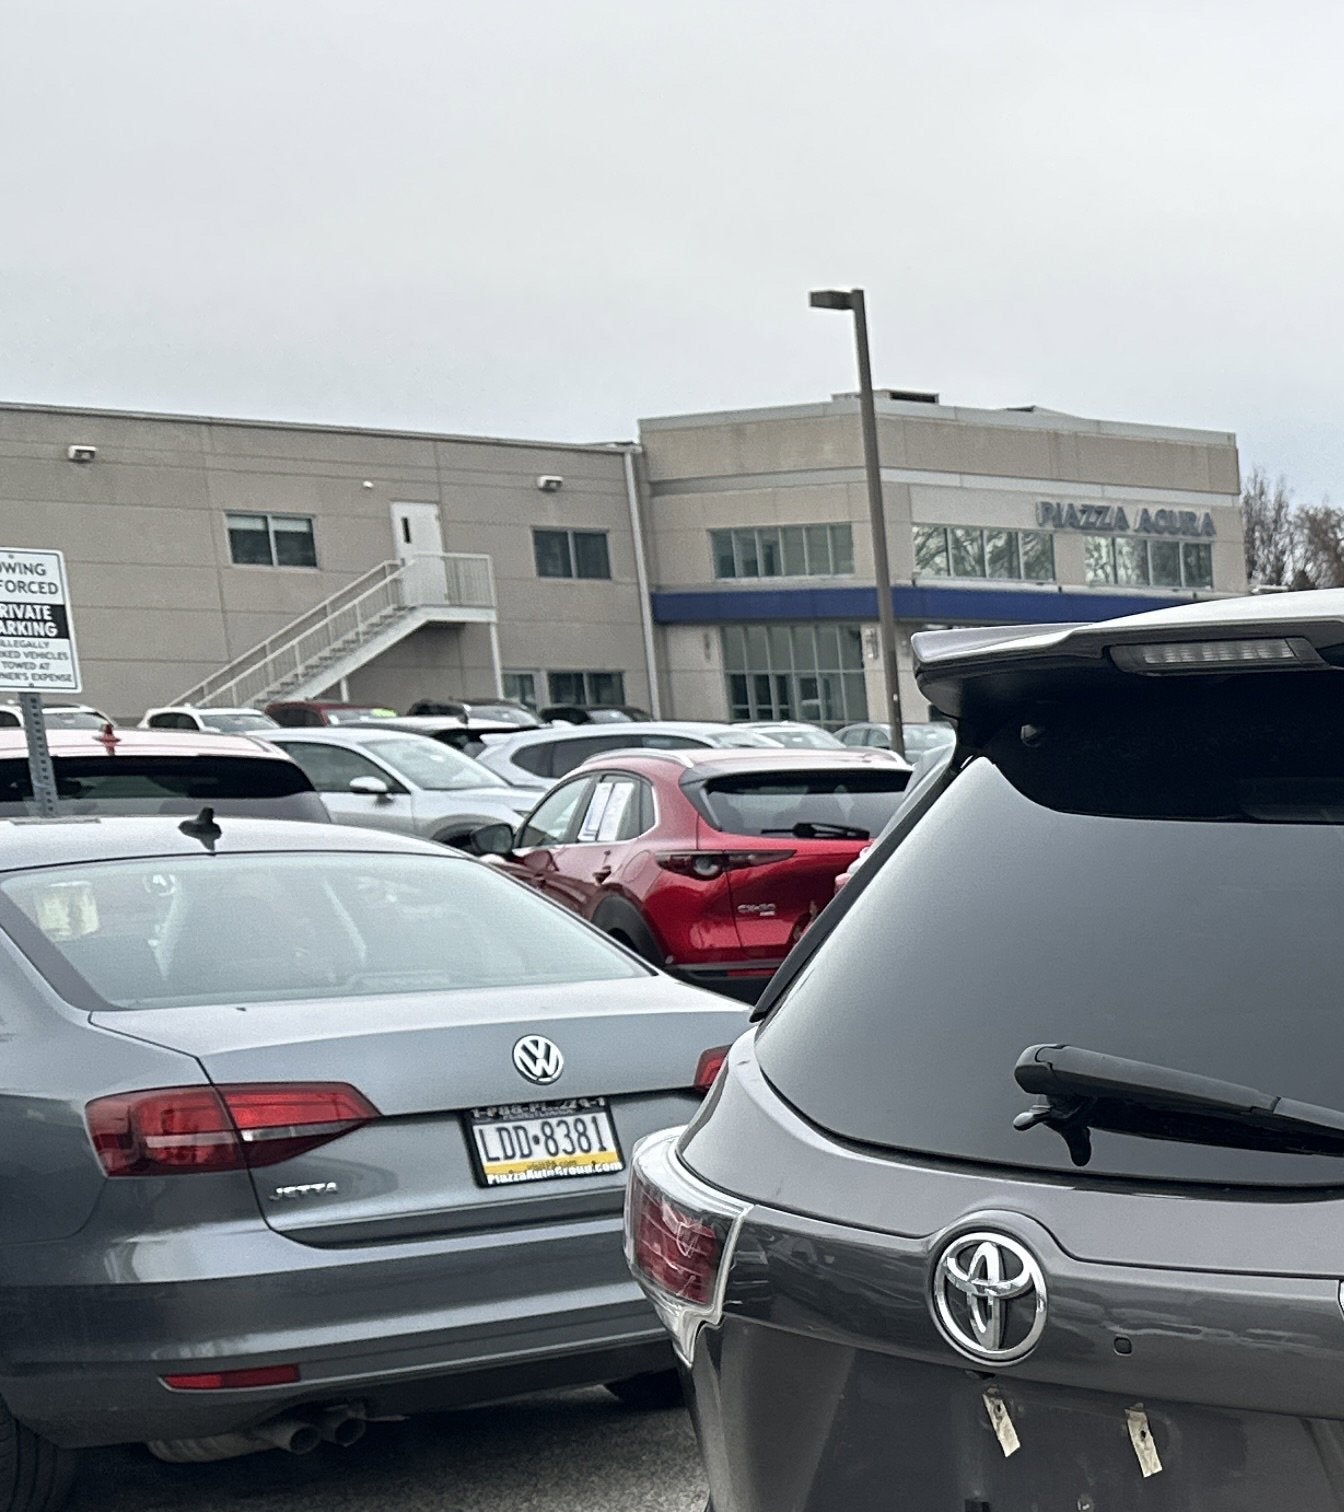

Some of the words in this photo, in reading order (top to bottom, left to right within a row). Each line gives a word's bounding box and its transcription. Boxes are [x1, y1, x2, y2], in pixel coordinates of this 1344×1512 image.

[1036, 501, 1130, 532] PIAZZA
[1133, 507, 1217, 537] ACURA
[0, 561, 47, 576] WING
